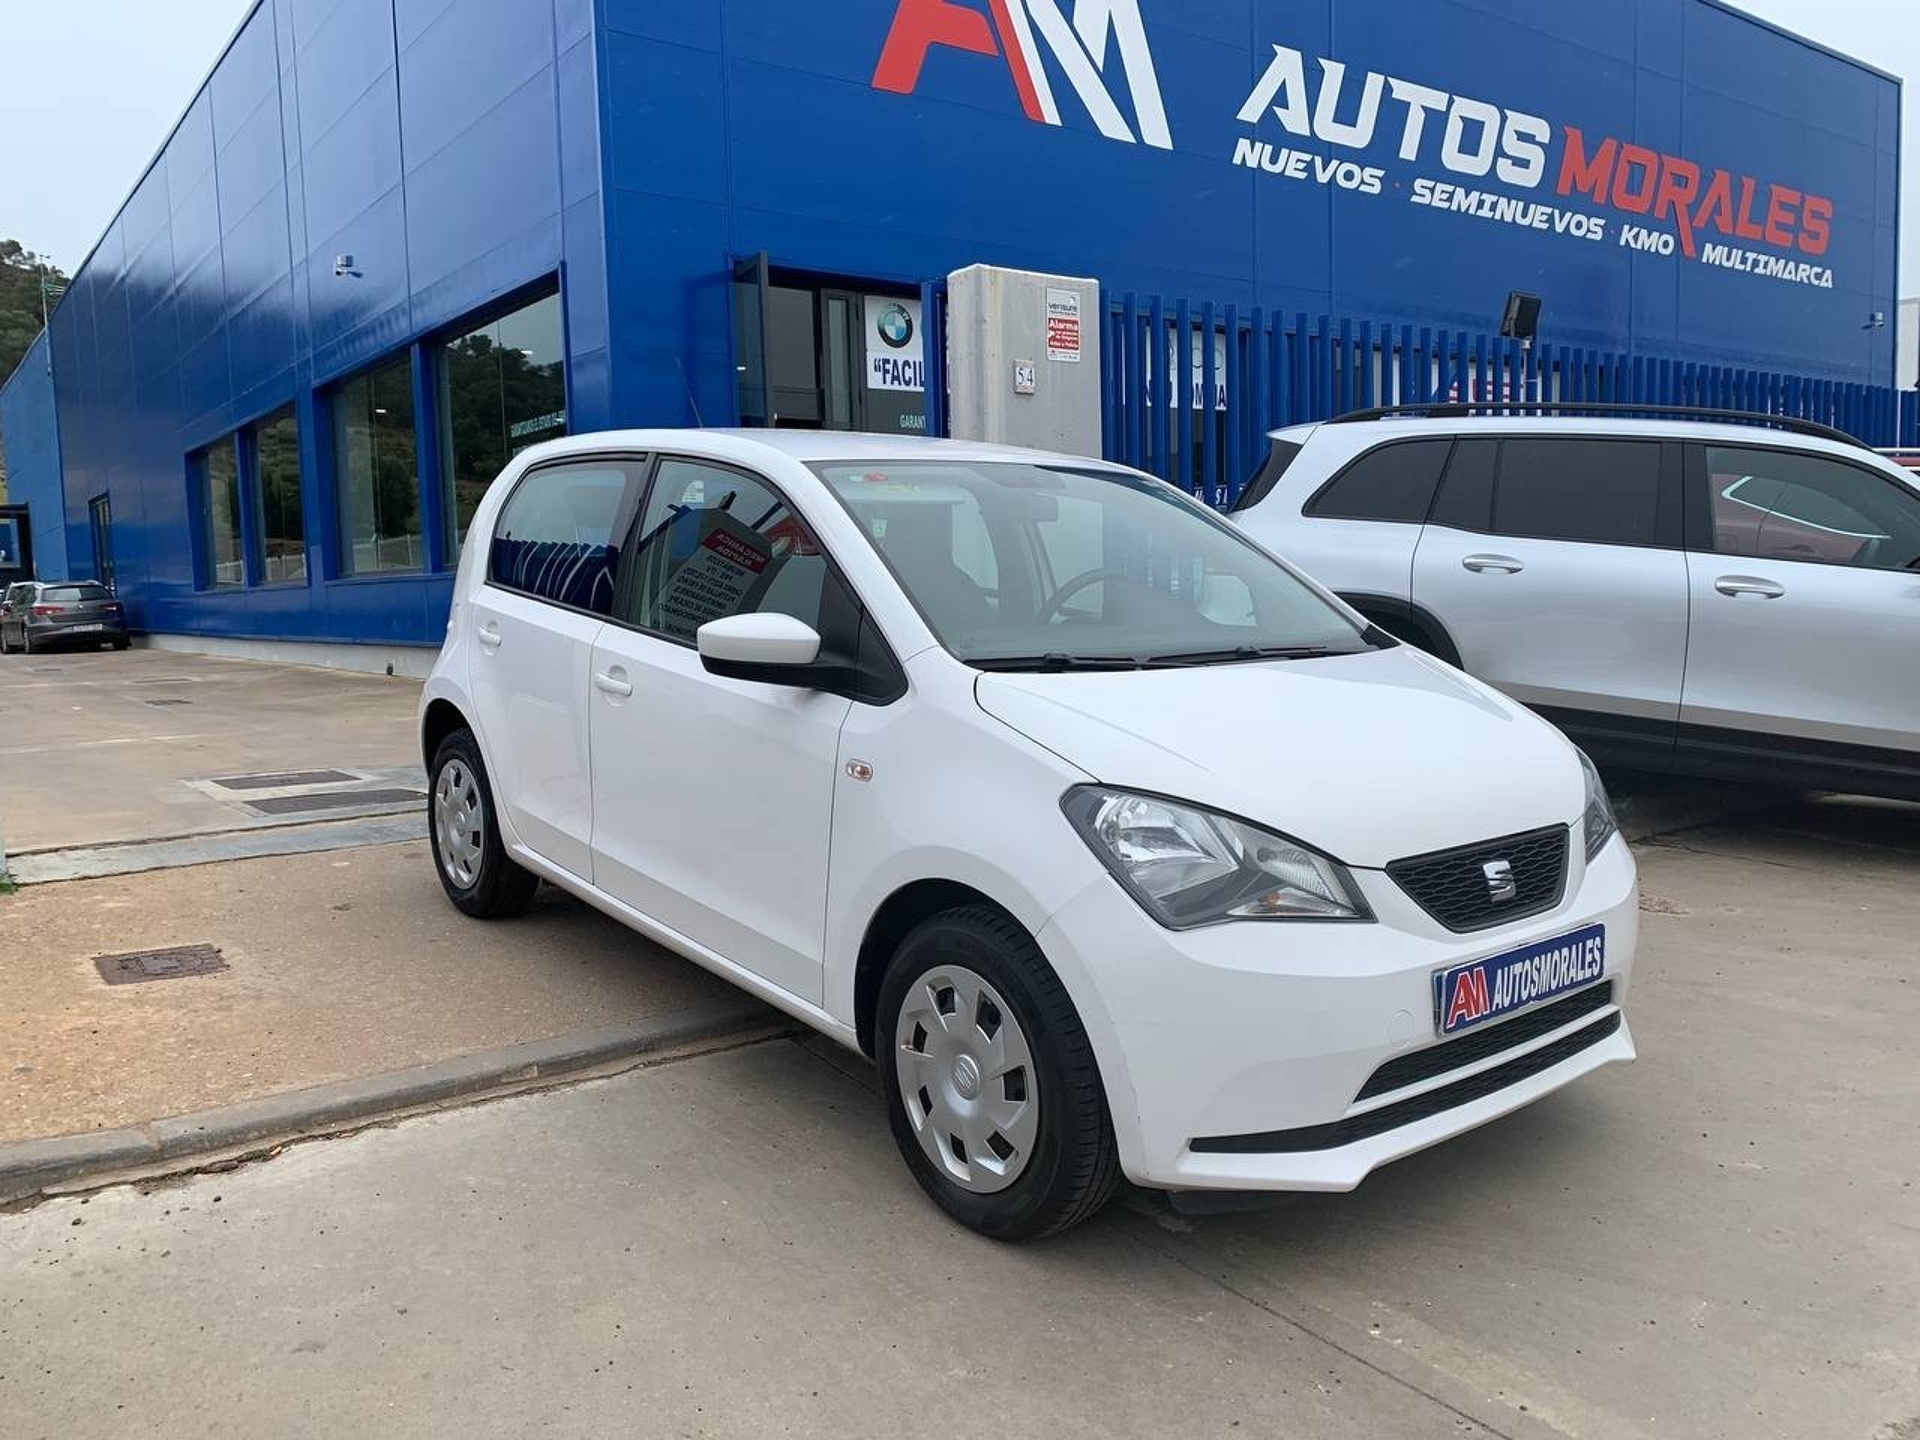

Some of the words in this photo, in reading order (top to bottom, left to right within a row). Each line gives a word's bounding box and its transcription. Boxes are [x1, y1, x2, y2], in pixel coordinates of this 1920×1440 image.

[1232, 137, 1385, 195] NUEVOS
[1410, 178, 1606, 241] SEMINUEVOS
[1701, 242, 1834, 289] MULTIMARCA
[1236, 43, 1551, 188] AUTOS
[1556, 125, 1834, 258] MORALES
[1492, 935, 1601, 1012] AUTOSMORALES
